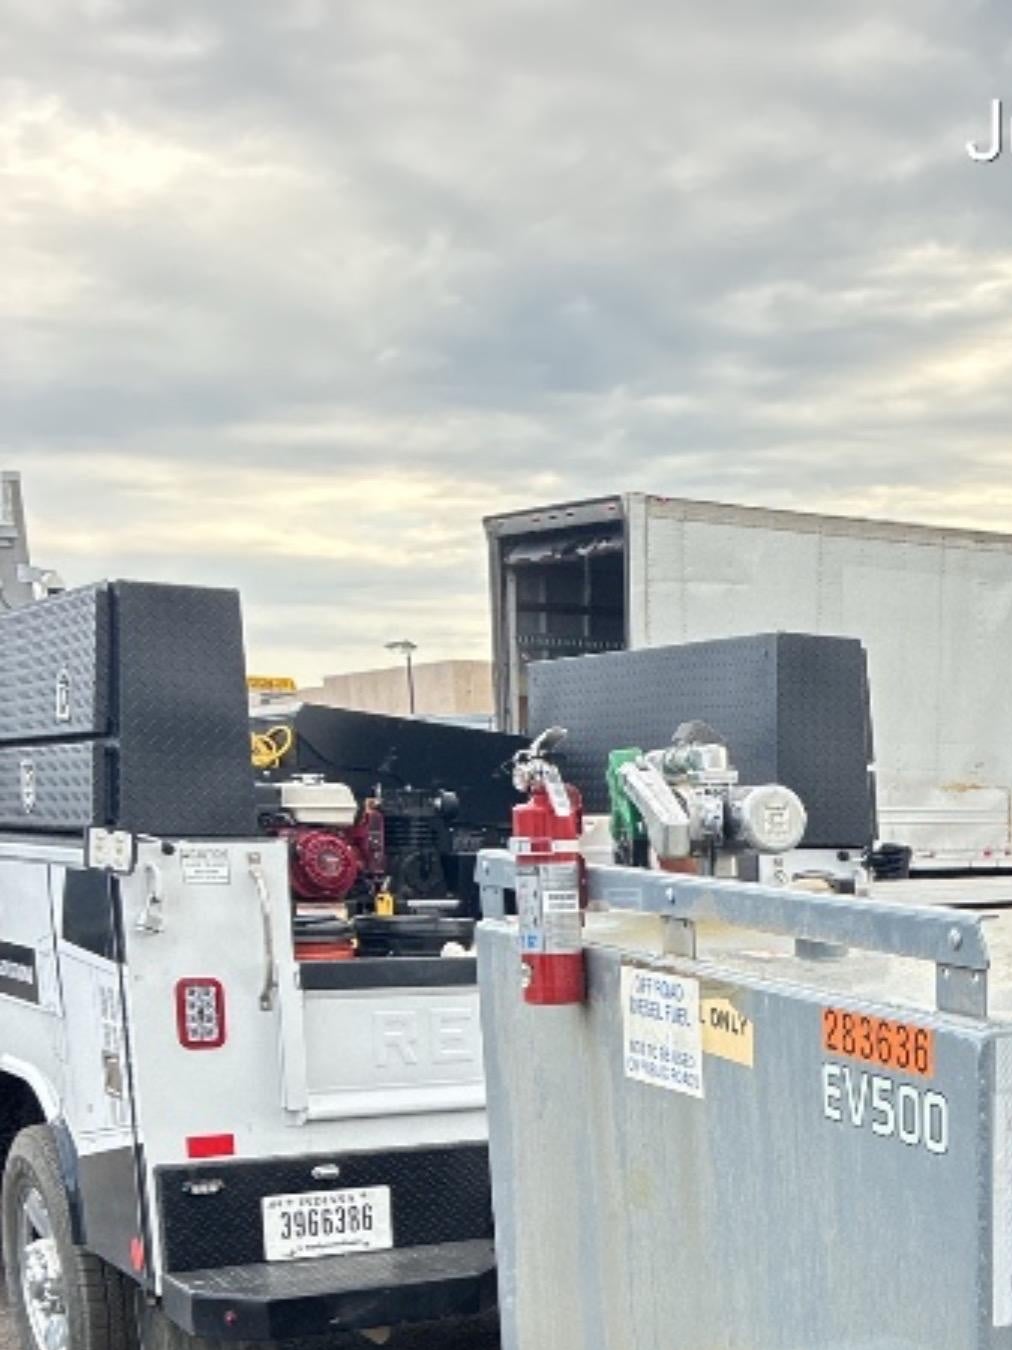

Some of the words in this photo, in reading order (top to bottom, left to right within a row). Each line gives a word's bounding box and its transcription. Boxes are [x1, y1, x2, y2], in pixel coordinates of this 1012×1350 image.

[709, 1007, 749, 1037] ONLY
[823, 1007, 929, 1075] 283636
[822, 1062, 949, 1155] EV500
